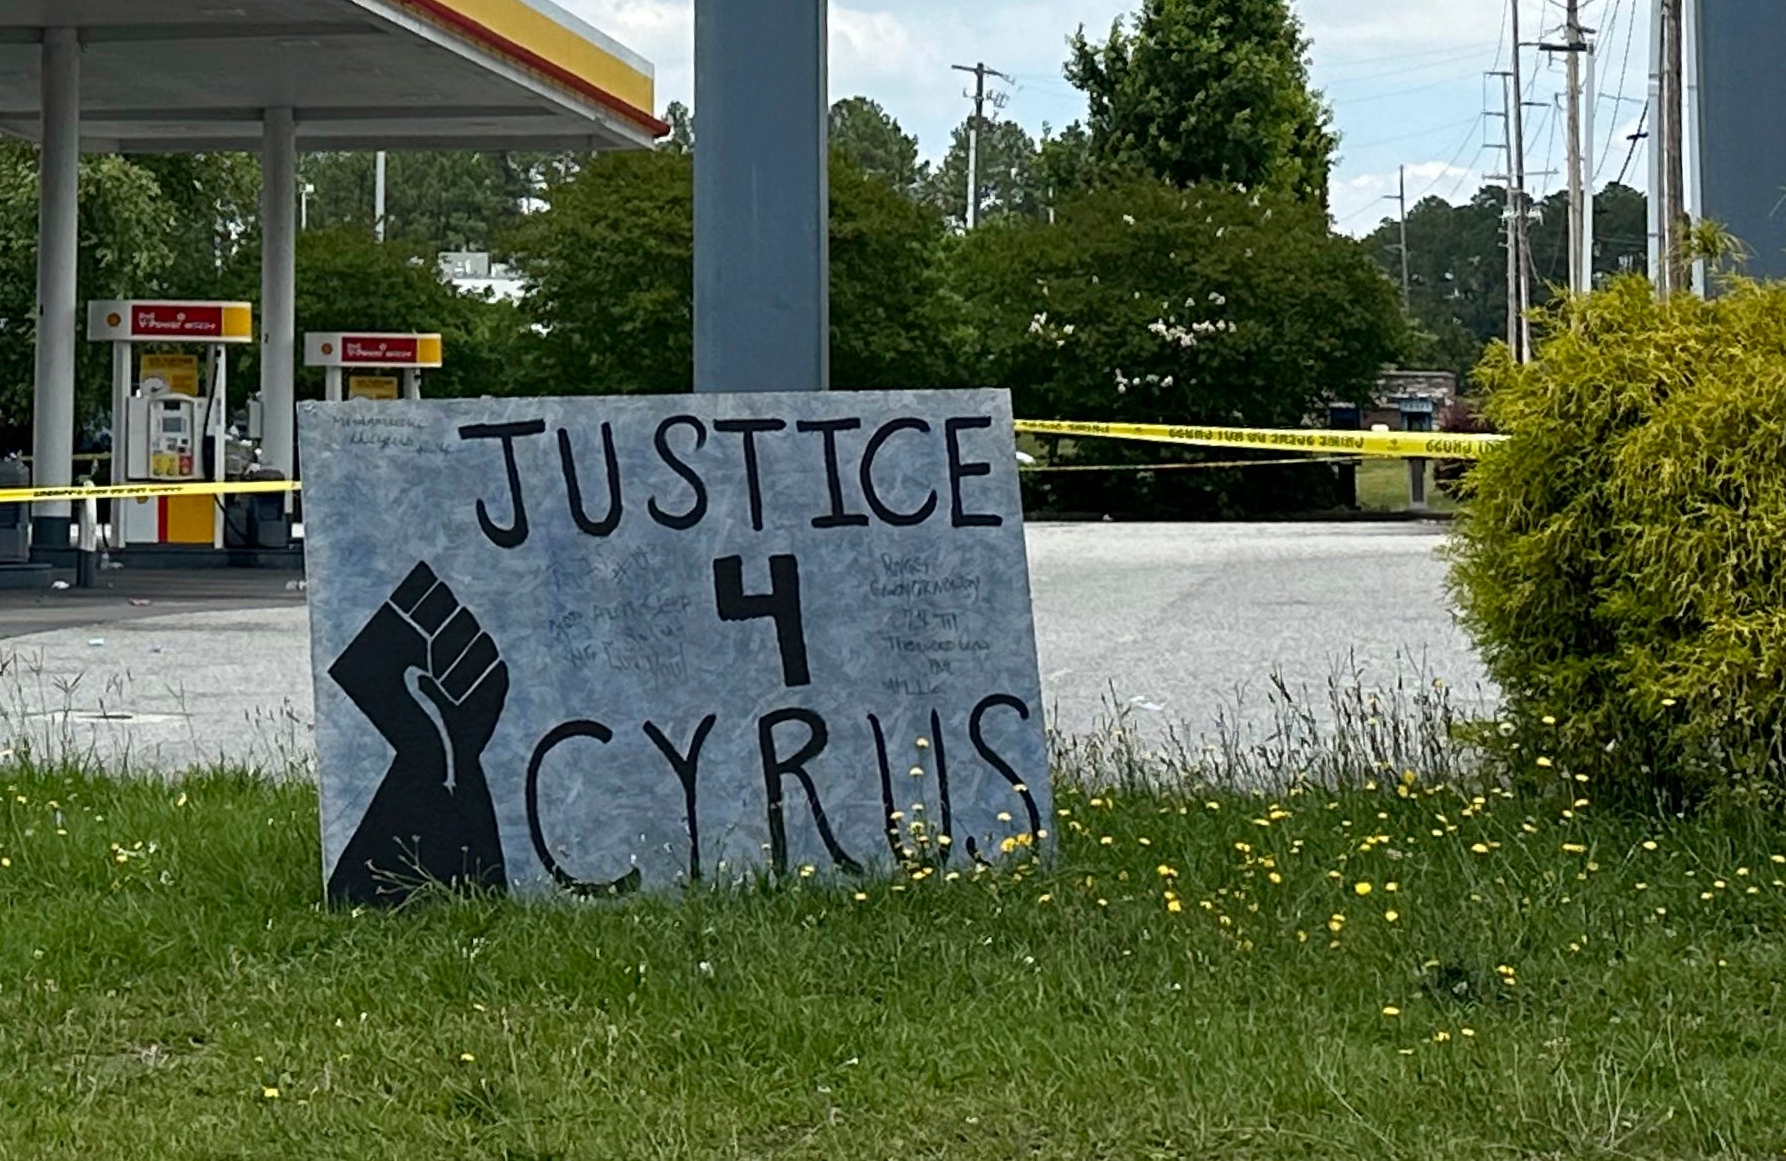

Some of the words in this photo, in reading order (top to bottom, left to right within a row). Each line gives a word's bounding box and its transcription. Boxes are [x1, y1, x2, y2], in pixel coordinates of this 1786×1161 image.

[458, 415, 1003, 548] JUSTICE
[713, 553, 811, 688] 4
[524, 692, 1042, 900] CYRUS
